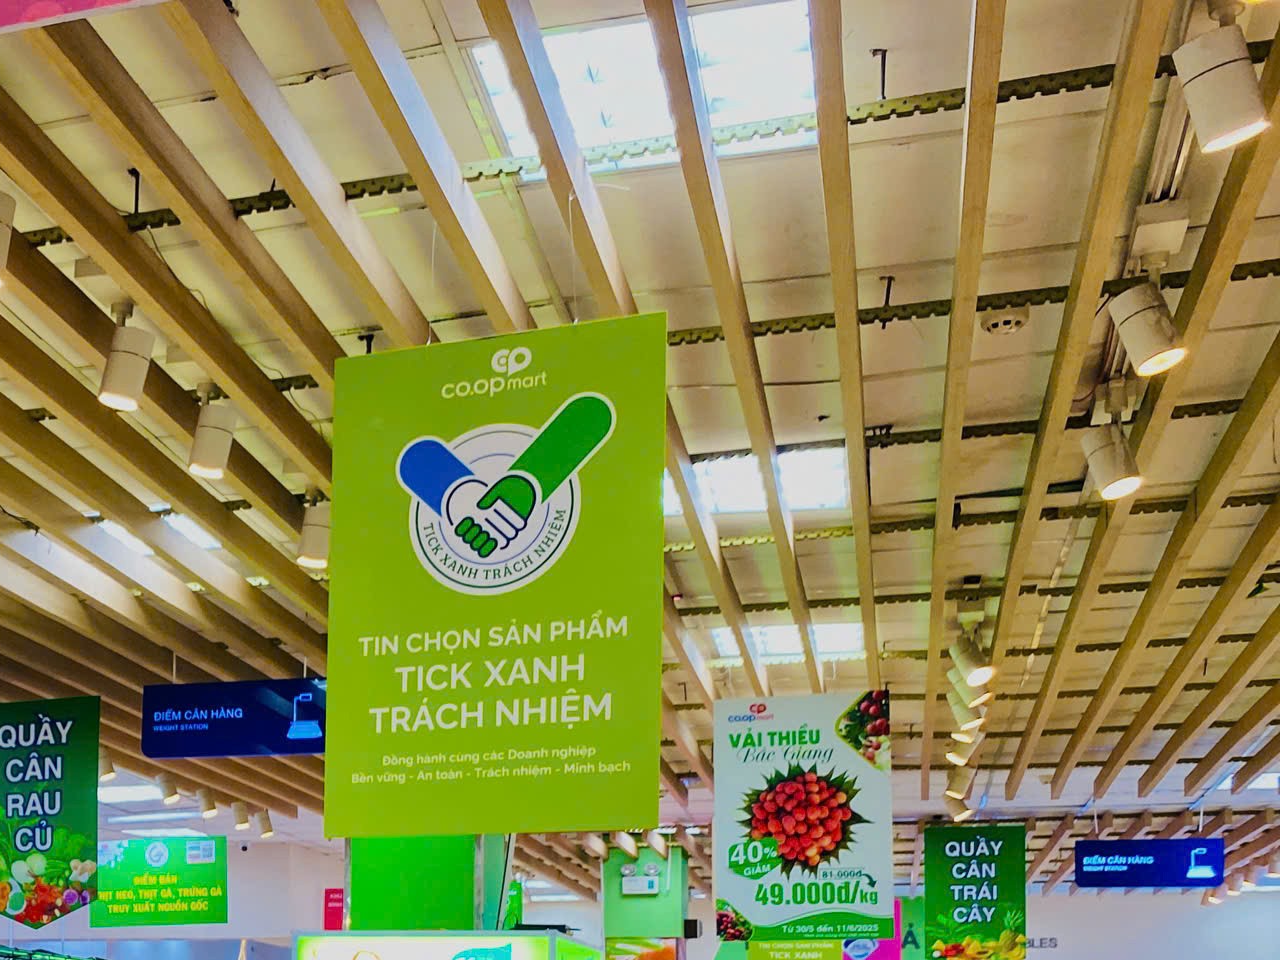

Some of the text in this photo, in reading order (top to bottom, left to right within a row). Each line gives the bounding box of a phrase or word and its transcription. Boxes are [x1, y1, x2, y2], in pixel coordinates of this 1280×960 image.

[358, 609, 628, 657] TIN CHỌN SẢN PHẨM
[394, 653, 585, 693] TICK XANH
[154, 706, 243, 721] ĐIỂM CÂN HÀNG
[369, 688, 612, 734] TRÁCH NHIỆM
[728, 727, 762, 748] VẢI
[382, 744, 597, 768] Đồng hành cùng các Doanh nghiệp
[783, 746, 834, 763] Giang
[5, 751, 62, 783] CÂN
[6, 792, 61, 817] RAU
[15, 820, 53, 852] CỦ
[945, 835, 1003, 858] QUẦY
[731, 841, 777, 865] 40%
[744, 863, 770, 876] GIẢM
[952, 860, 996, 879] CÂN
[754, 880, 878, 905] 49.000đ/kg
[950, 882, 998, 900] TRÁI
[953, 903, 997, 923] CÂY
[782, 923, 878, 933] Từ 30/5 đến 11/6/2025
